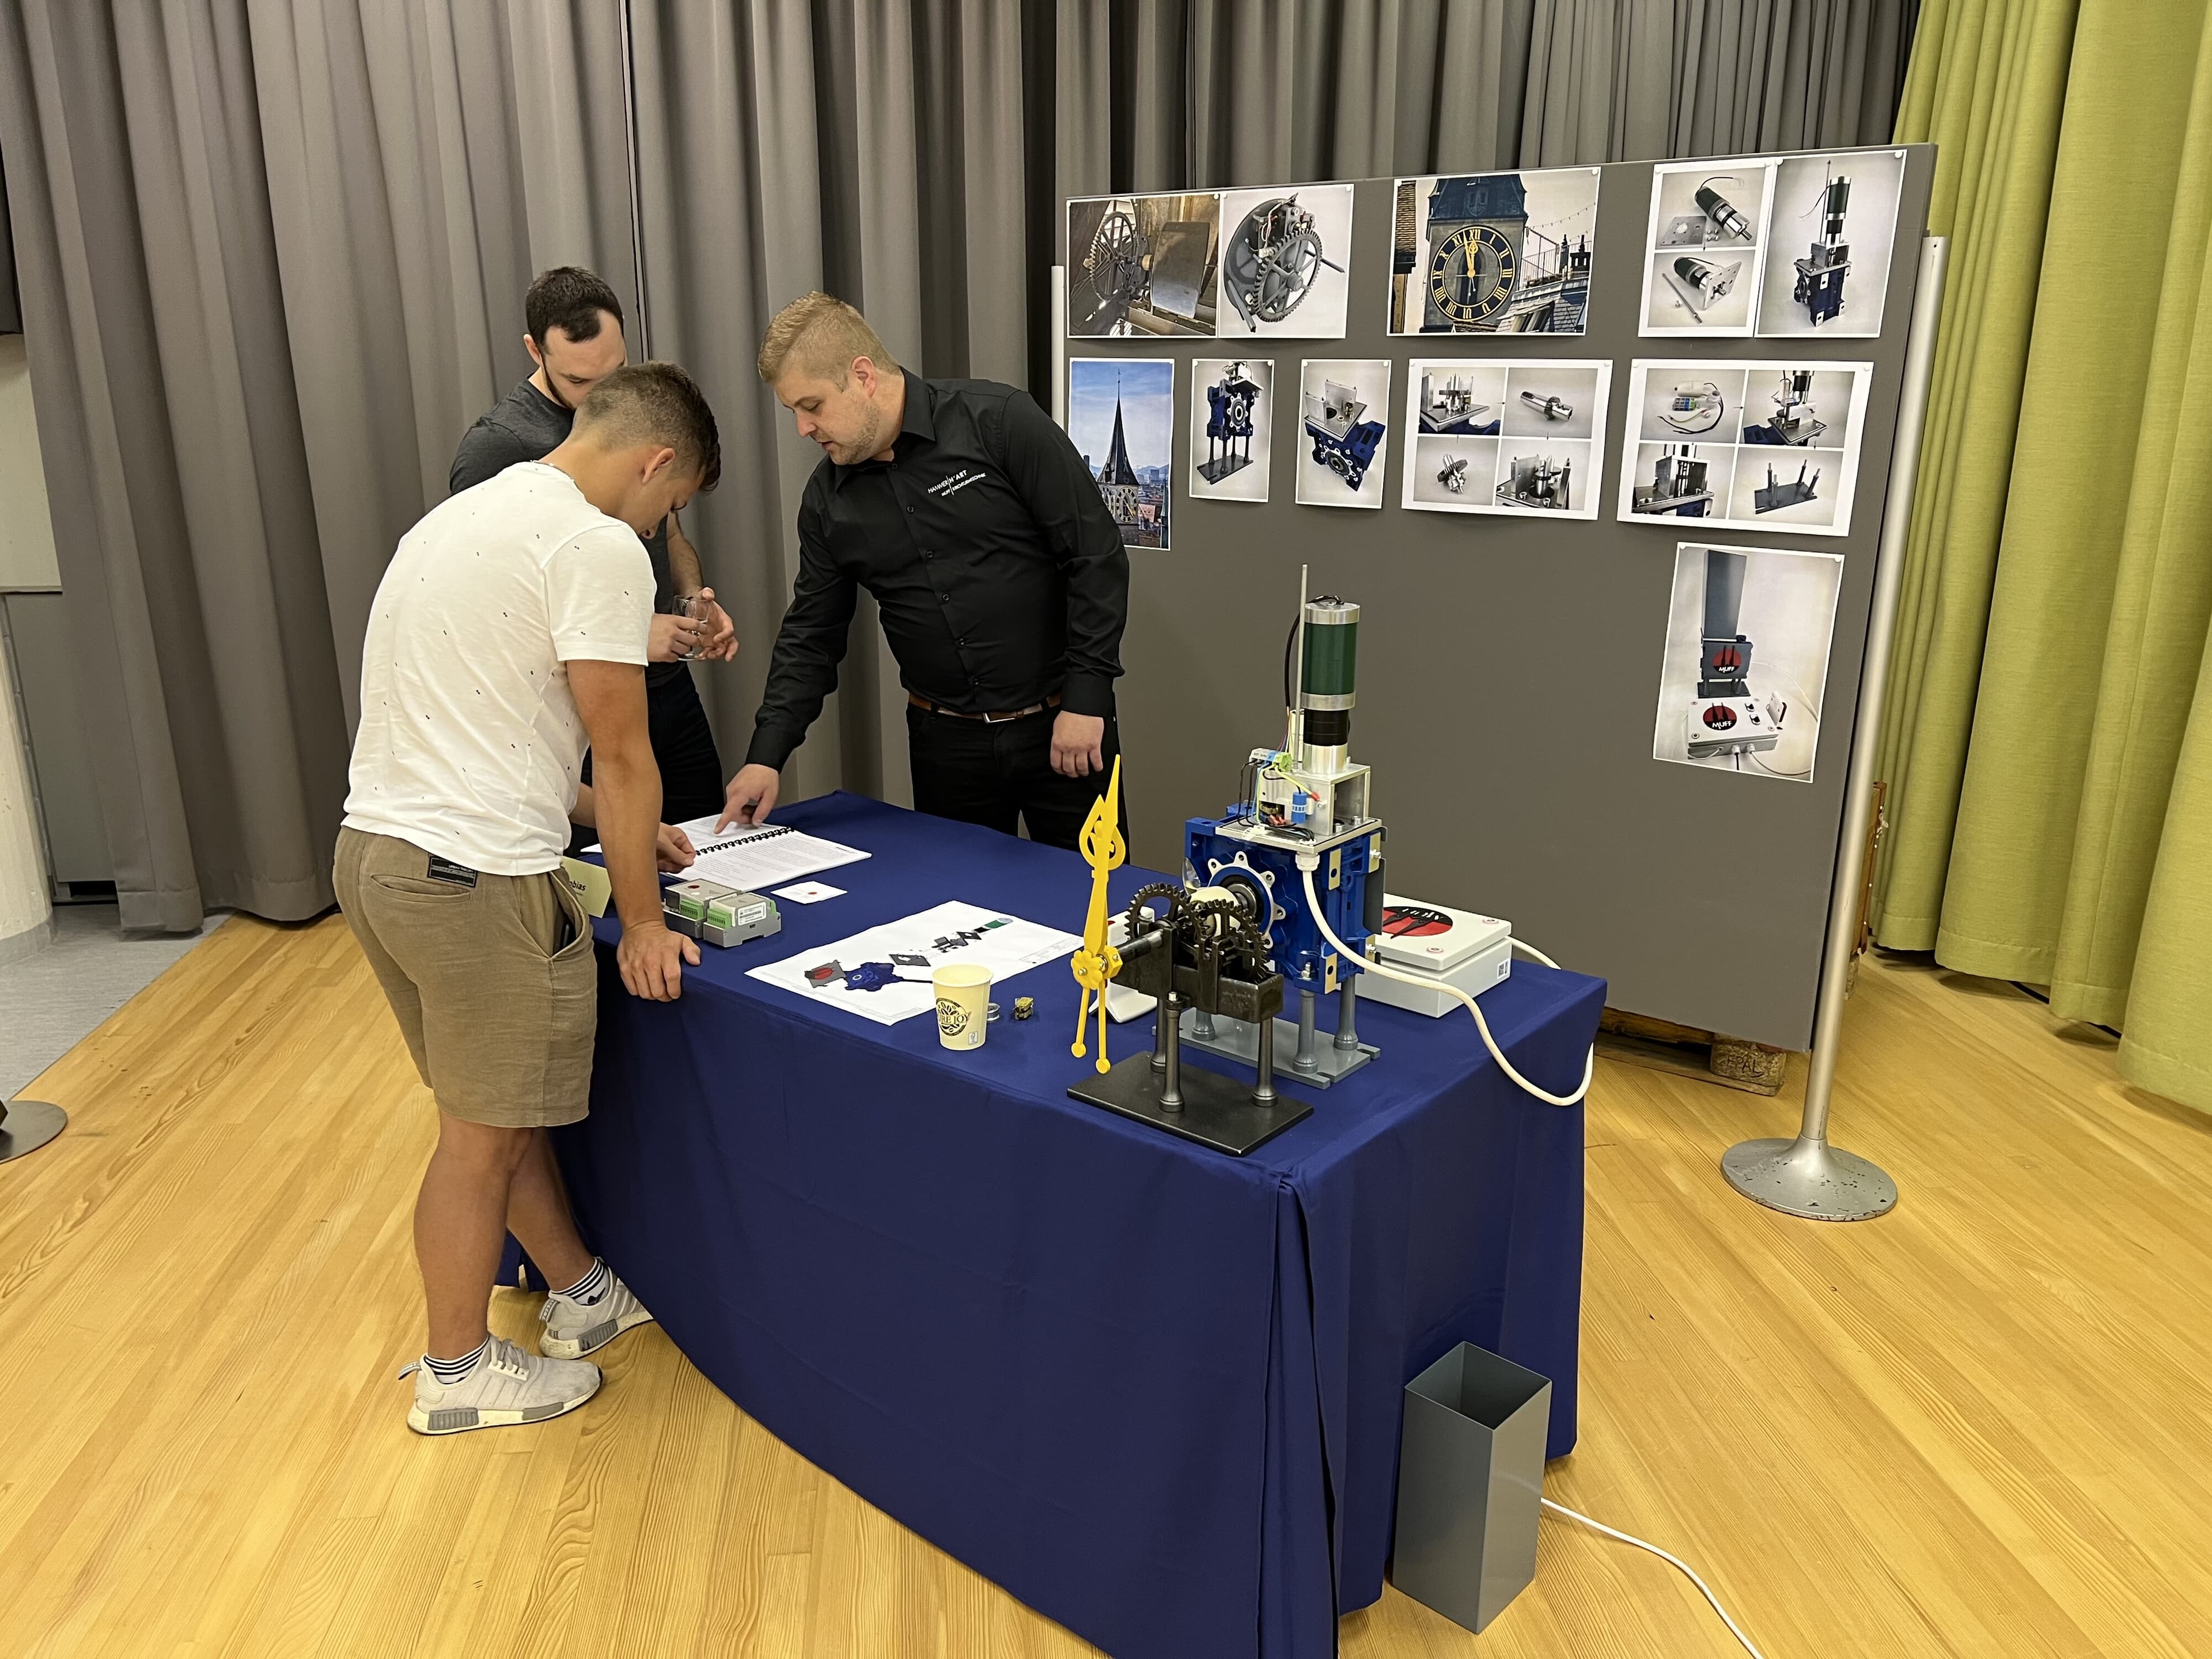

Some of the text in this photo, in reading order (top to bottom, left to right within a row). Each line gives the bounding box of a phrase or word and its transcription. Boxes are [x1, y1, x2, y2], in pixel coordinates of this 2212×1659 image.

[1452, 234, 1462, 247] XI
[1489, 234, 1496, 244] I
[1439, 250, 1449, 259] X
[1499, 248, 1510, 259] II
[1502, 268, 1513, 278] III
[949, 469, 967, 483] H'ART
[1712, 721, 1732, 730] MUFF
[569, 880, 586, 891] obias
[953, 1012, 972, 1025] JOY
